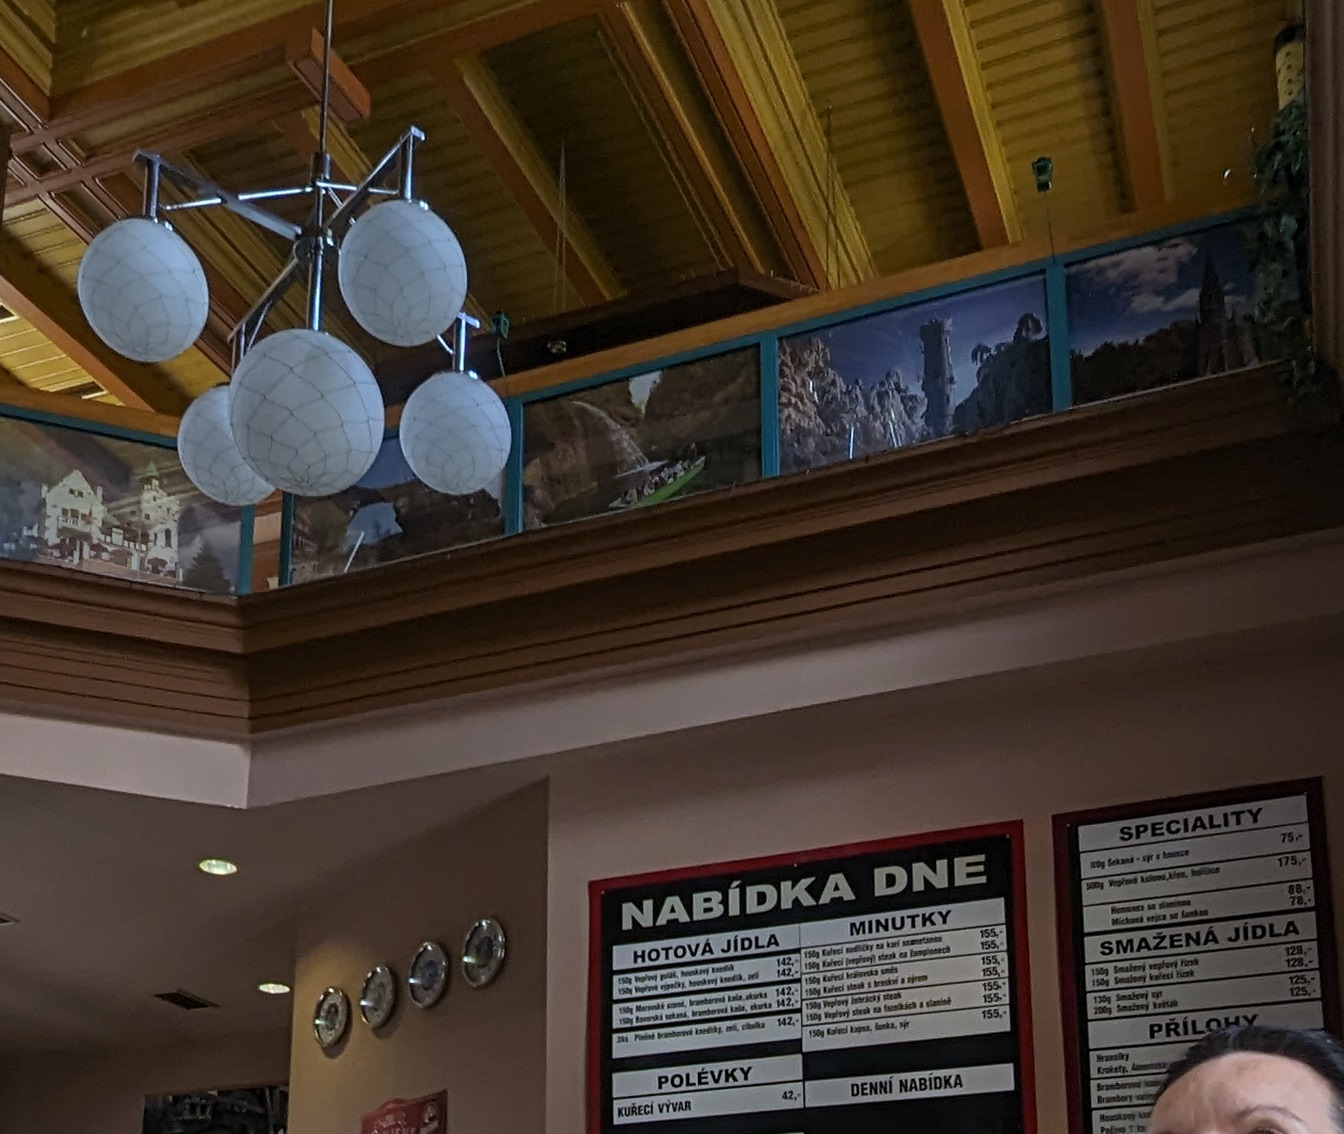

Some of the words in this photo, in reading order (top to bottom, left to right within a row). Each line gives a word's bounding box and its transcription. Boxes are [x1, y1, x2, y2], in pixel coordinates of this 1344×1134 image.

[1119, 807, 1263, 842] SPECIALITY
[1280, 830, 1302, 843] 75,-
[1278, 854, 1306, 868] 175,-
[621, 873, 855, 930] NABÍDKA
[873, 854, 988, 897] DNE
[849, 909, 951, 936] MINUTKY
[633, 941, 714, 964] HOTOVÁ
[720, 933, 780, 954] JÍDLA
[803, 949, 819, 960] 150g
[980, 927, 1003, 939] 155,-
[1099, 927, 1219, 957] SMAŽENÁ
[1227, 920, 1300, 943] JÍDLA
[804, 961, 819, 971] 150g
[980, 938, 1003, 950] 155,-
[618, 976, 631, 986] 150g
[776, 955, 798, 967] 142,-
[777, 967, 798, 978] 142,-
[804, 975, 820, 985] 150g
[981, 954, 1004, 966] 155,-
[982, 966, 1004, 978] 155,-
[1091, 966, 1108, 976] 150g
[1092, 977, 1109, 987] 150g
[1288, 973, 1315, 985] 125,-
[775, 986, 798, 998] 142,-
[776, 997, 798, 1009] 142,-
[805, 1000, 821, 1011] 150g
[982, 980, 1005, 991] 155,-
[805, 1012, 821, 1022] 150g
[982, 992, 1005, 1003] 155,-
[776, 1016, 799, 1027] 142,-
[808, 1029, 824, 1039] 150g
[981, 1007, 1006, 1020] 155,-
[1148, 1014, 1260, 1040] PŘÍLOHY
[657, 1066, 753, 1091] POLÉVKY
[850, 1076, 894, 1097] DENNÍ
[898, 1073, 964, 1094] NABÍDKA
[617, 1099, 654, 1118] KUŘECÍ
[658, 1098, 692, 1116] VÝVAR
[781, 1089, 801, 1101] 42,-
